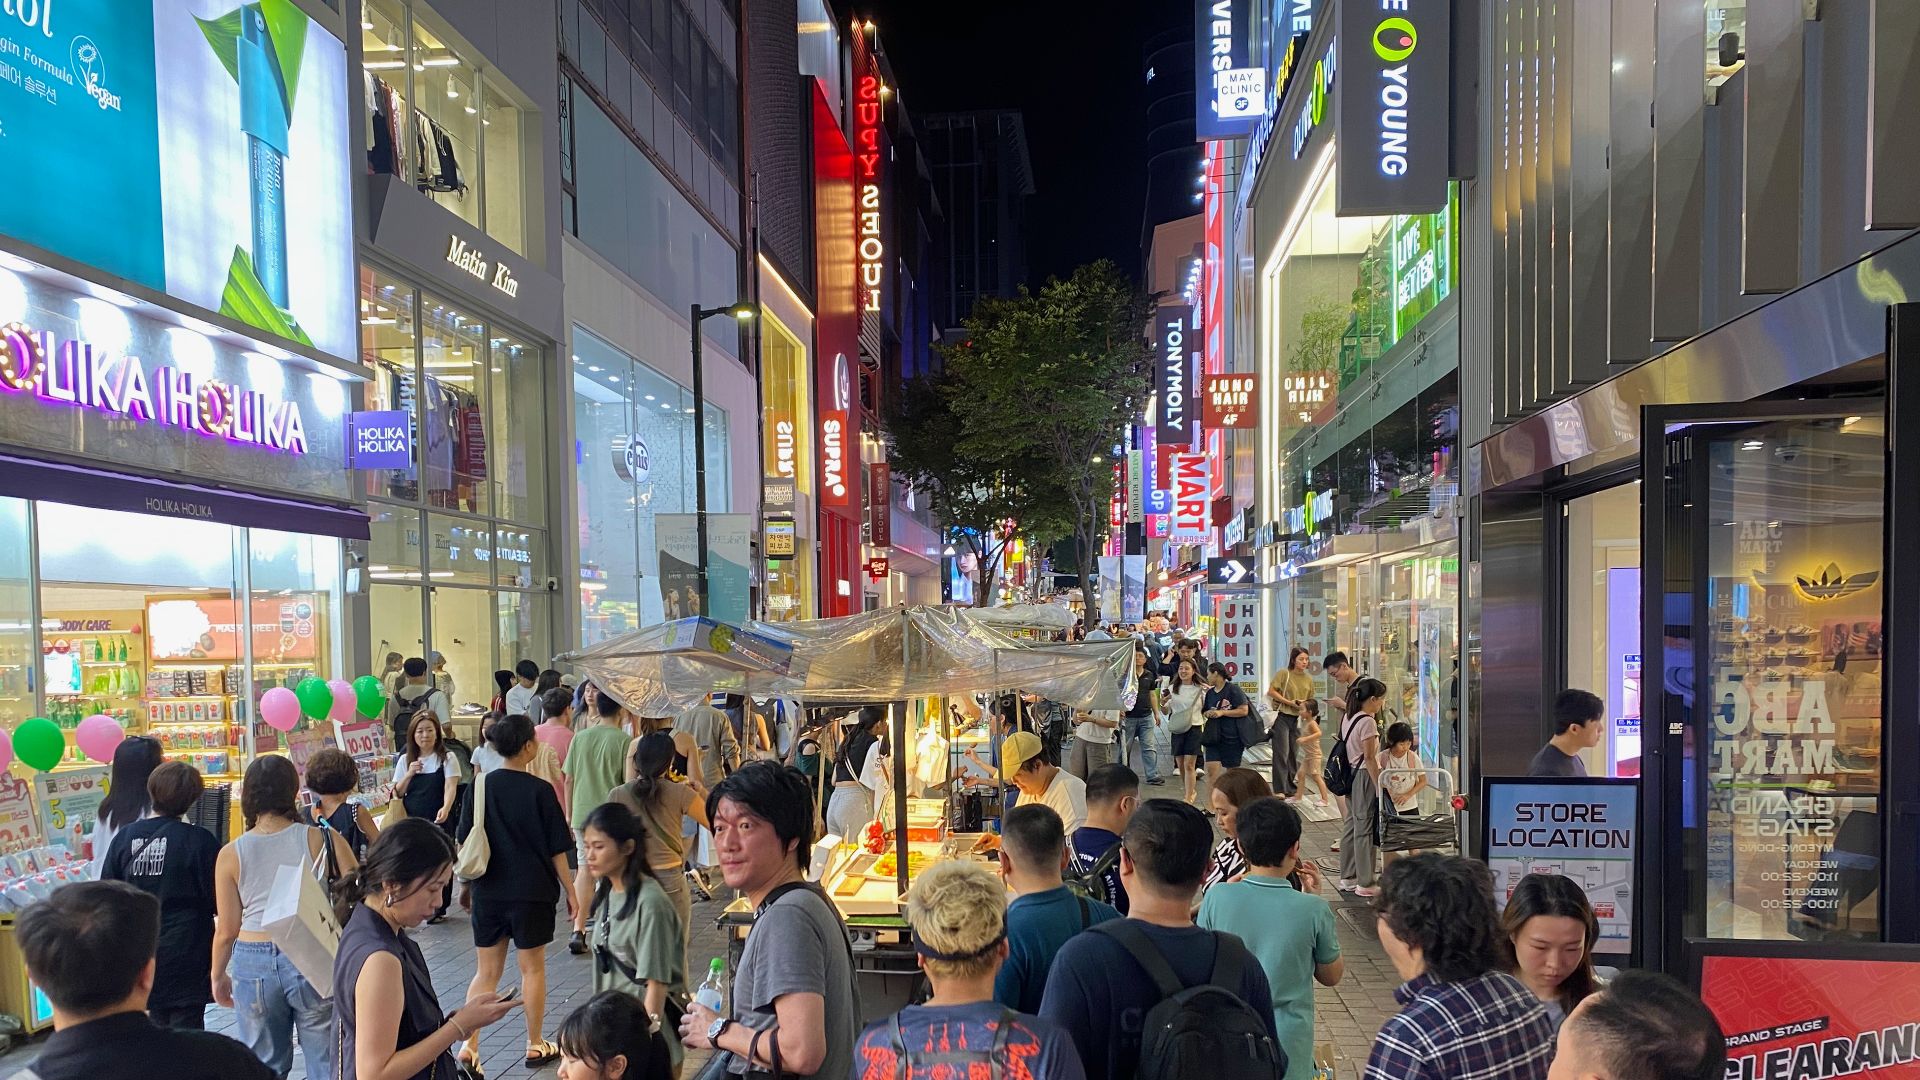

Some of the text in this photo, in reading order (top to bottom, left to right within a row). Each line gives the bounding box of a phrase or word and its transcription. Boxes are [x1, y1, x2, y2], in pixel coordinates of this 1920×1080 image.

[24, 46, 73, 86] Formula
[1229, 73, 1253, 83] MAY
[24, 75, 57, 105] 솔루션
[86, 80, 121, 111] Vegan
[1221, 84, 1262, 95] CLINIC
[1236, 99, 1248, 109] 3F
[1381, 65, 1408, 176] YOUNG
[446, 235, 518, 298] Matin Kim
[1167, 318, 1183, 431] TONYMOLY
[1208, 379, 1254, 393] JUNO
[1213, 391, 1249, 405] HAIR
[167, 366, 309, 454] HOLIKA
[1222, 413, 1239, 425] 4F
[358, 427, 405, 440] HOLIKA
[358, 440, 406, 453] HOLIKA
[823, 419, 843, 487] SUPRA
[1177, 456, 1206, 532] MART
[145, 497, 214, 518] HOLIKA HOLIKA
[1740, 520, 1783, 540] ABC
[769, 542, 791, 550] 피부과
[1739, 541, 1783, 554] MART
[86, 619, 112, 631] CARE
[1224, 603, 1239, 677] JUNO
[1241, 604, 1255, 676] HAIR
[1669, 722, 1683, 730] ABC
[1515, 802, 1608, 823] STORE
[1490, 828, 1631, 849] LOCATION
[1774, 1019, 1823, 1037] STAGE
[1725, 1022, 1920, 1080] CLEARAN
